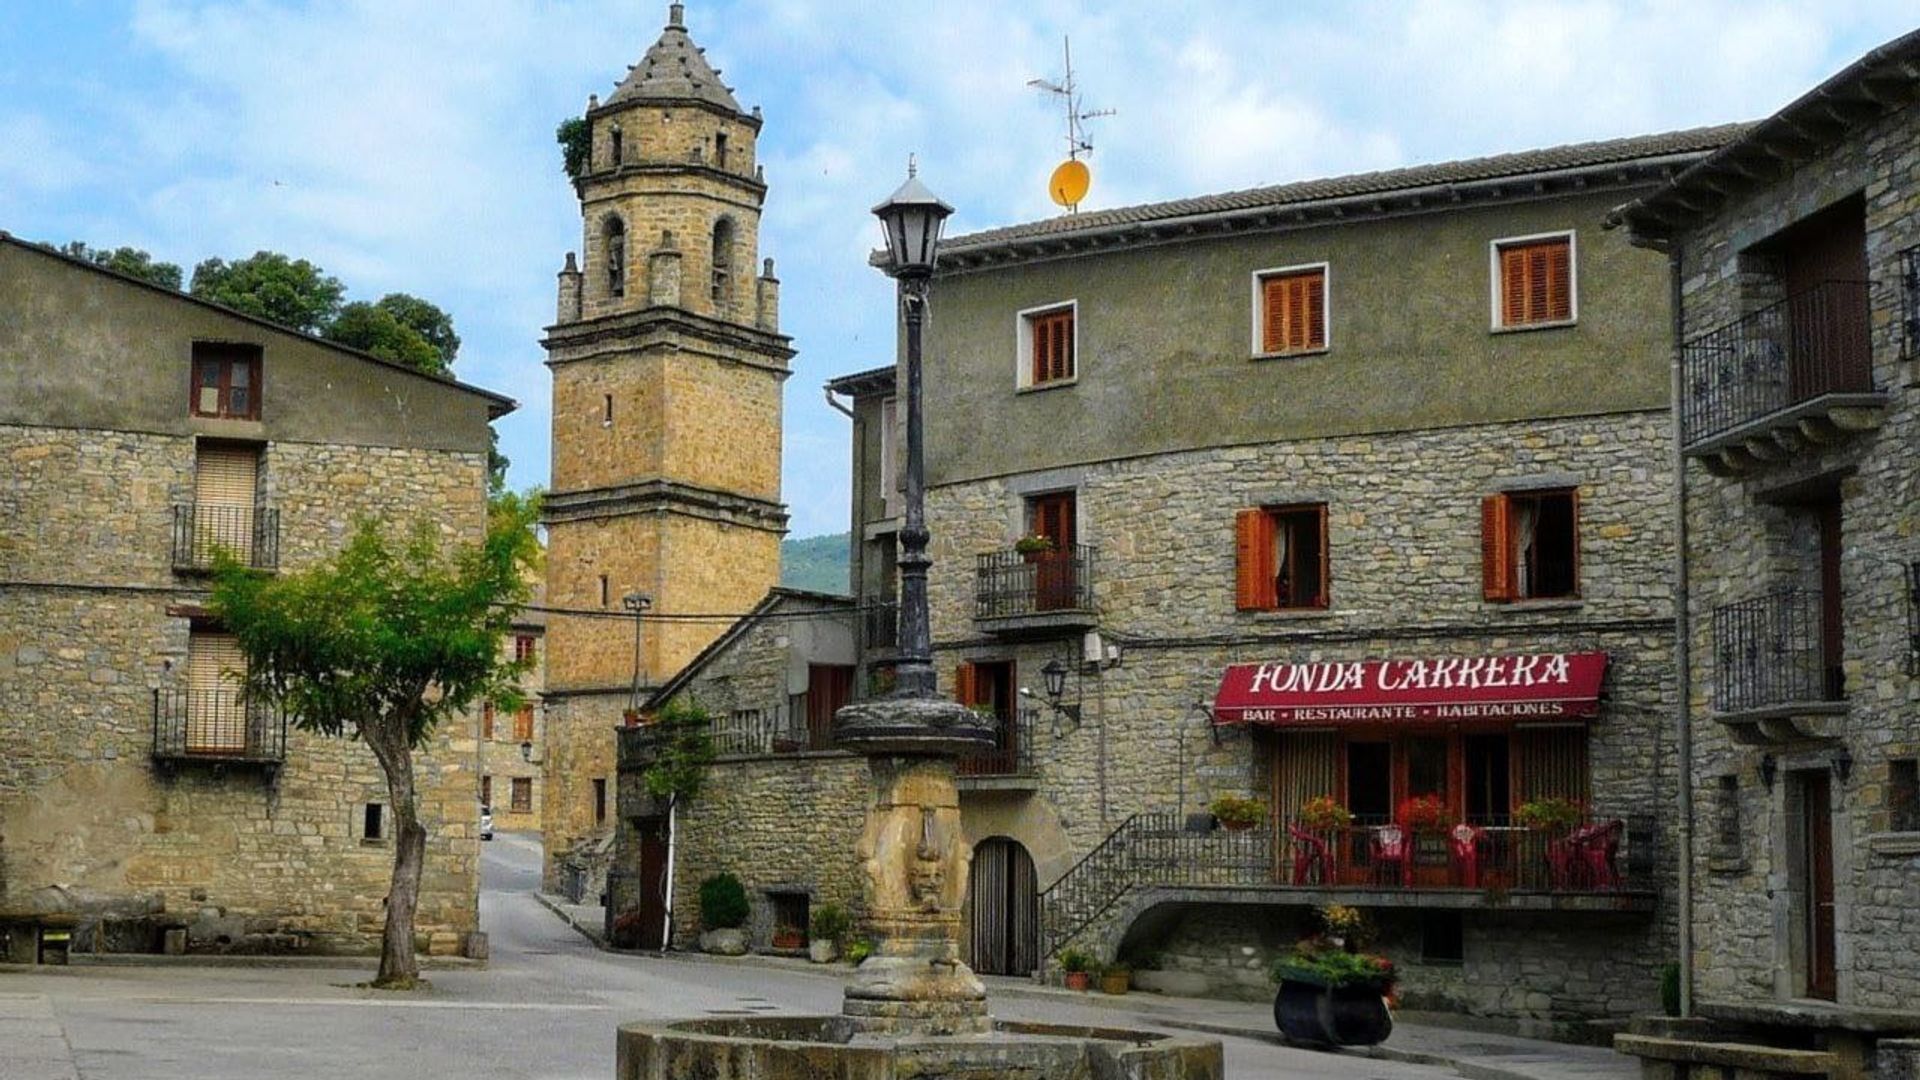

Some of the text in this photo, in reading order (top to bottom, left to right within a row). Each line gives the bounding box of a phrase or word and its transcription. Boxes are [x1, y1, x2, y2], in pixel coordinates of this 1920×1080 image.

[1249, 663, 1366, 692] FONDA
[1242, 702, 1563, 721] BAR RESTAURANTE HABITACIONES
